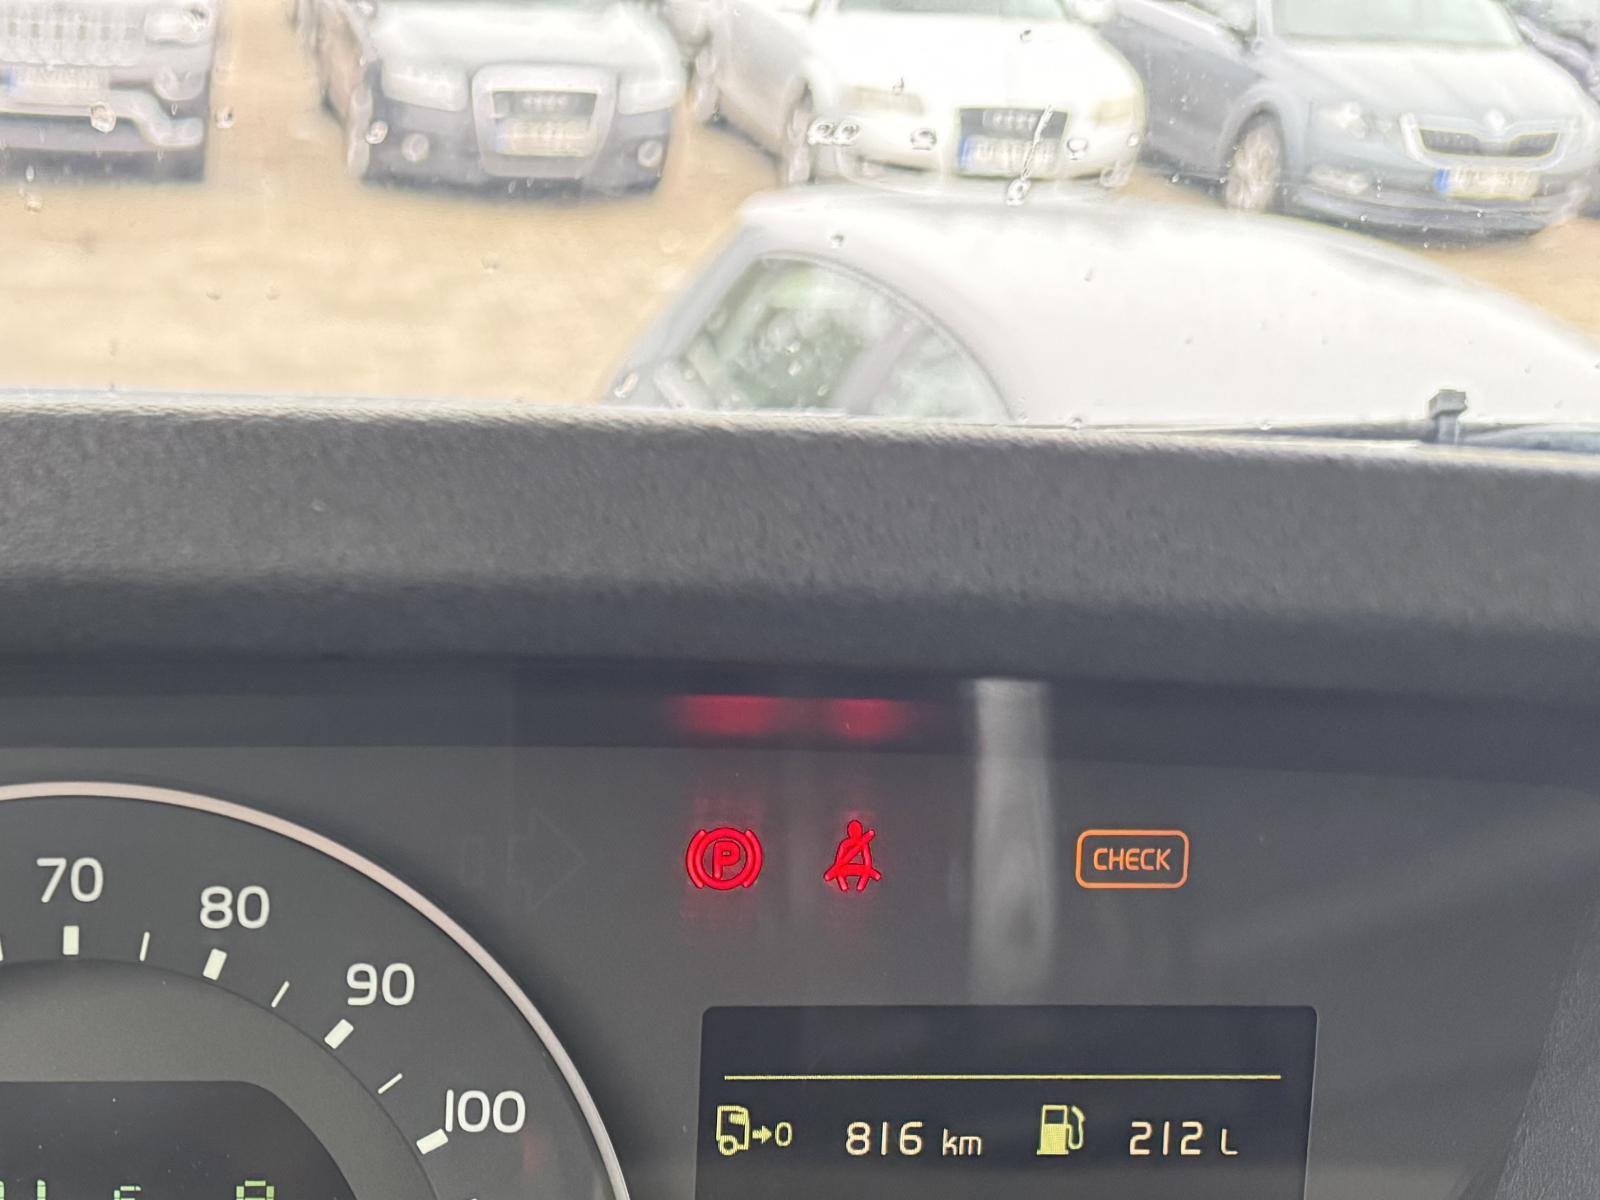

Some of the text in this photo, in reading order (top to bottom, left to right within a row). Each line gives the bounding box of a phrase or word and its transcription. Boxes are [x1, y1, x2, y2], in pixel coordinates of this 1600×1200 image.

[36, 857, 104, 904] 70
[1092, 847, 1172, 873] CHECK
[199, 885, 271, 930] 80
[345, 962, 417, 1007] 90
[444, 1088, 528, 1134] 100
[844, 1121, 983, 1157] 816 km
[1128, 1121, 1203, 1157] 212
